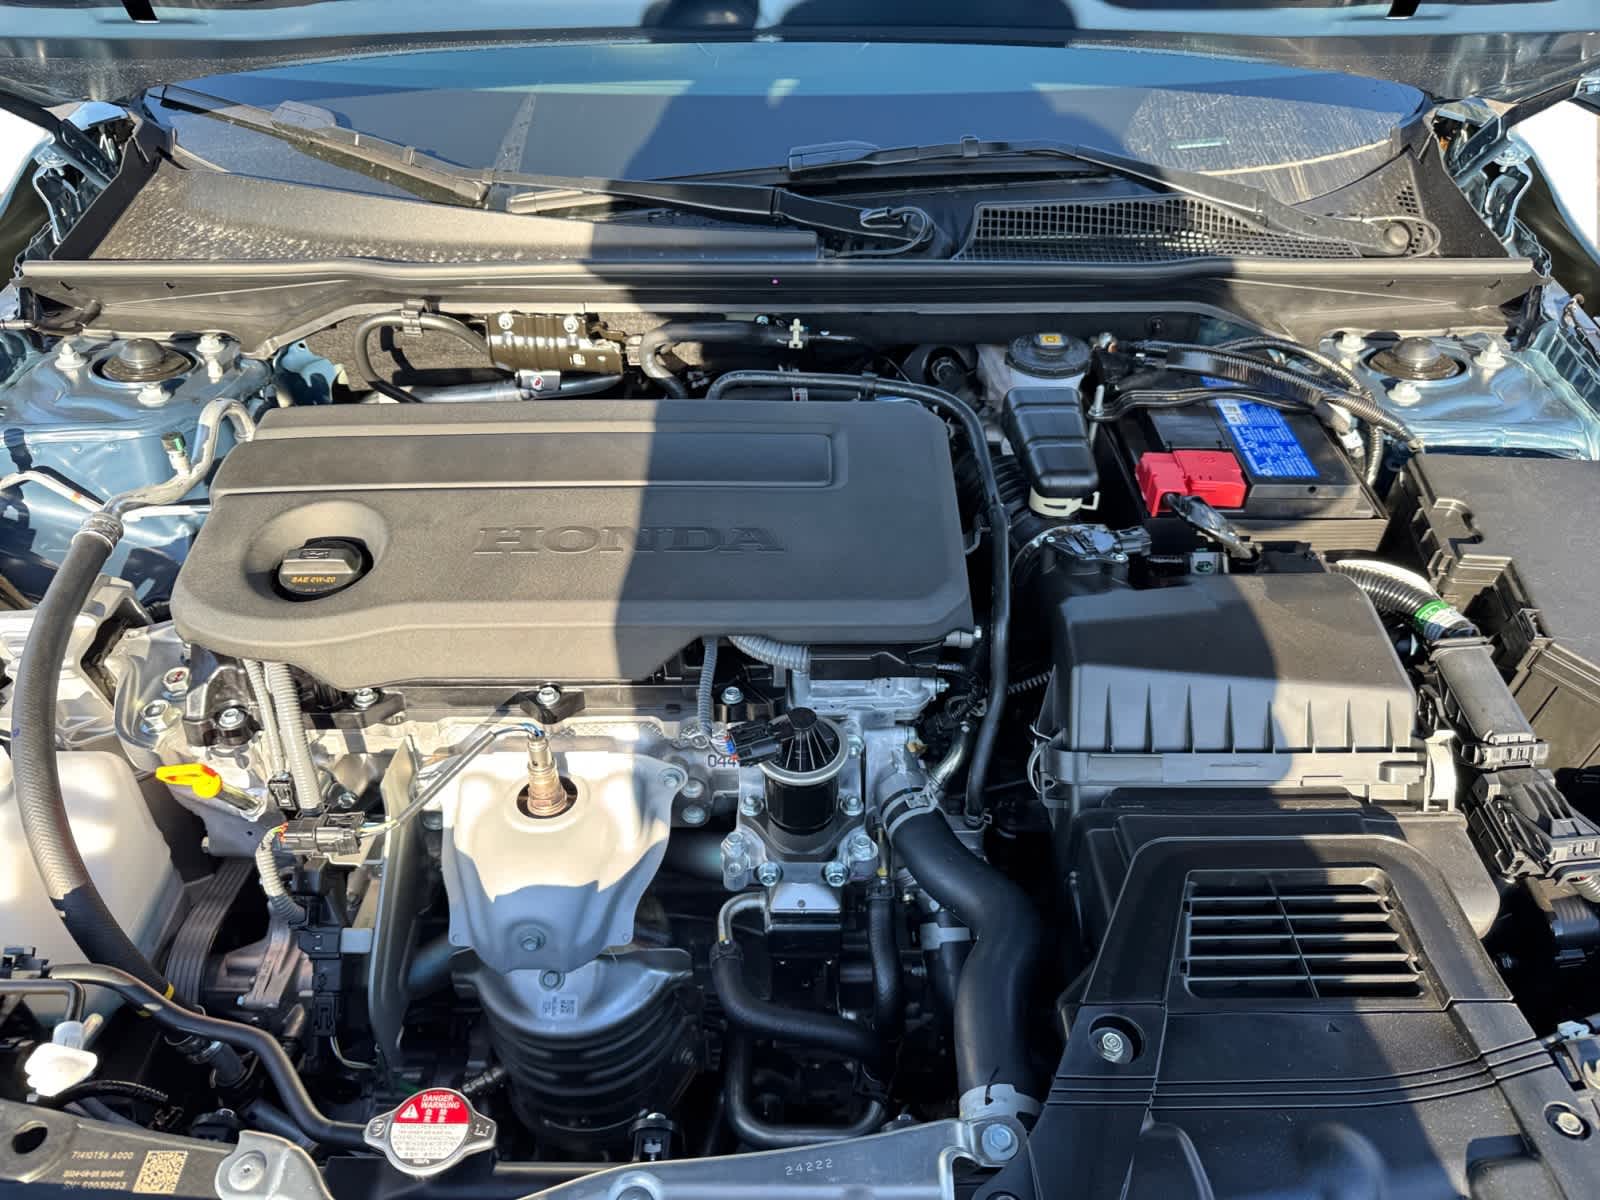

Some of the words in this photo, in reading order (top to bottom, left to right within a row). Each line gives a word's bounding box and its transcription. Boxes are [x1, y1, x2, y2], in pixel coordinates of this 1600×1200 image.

[474, 526, 784, 554] HONDA
[291, 576, 309, 584] SAE
[785, 1158, 833, 1176] 24222
